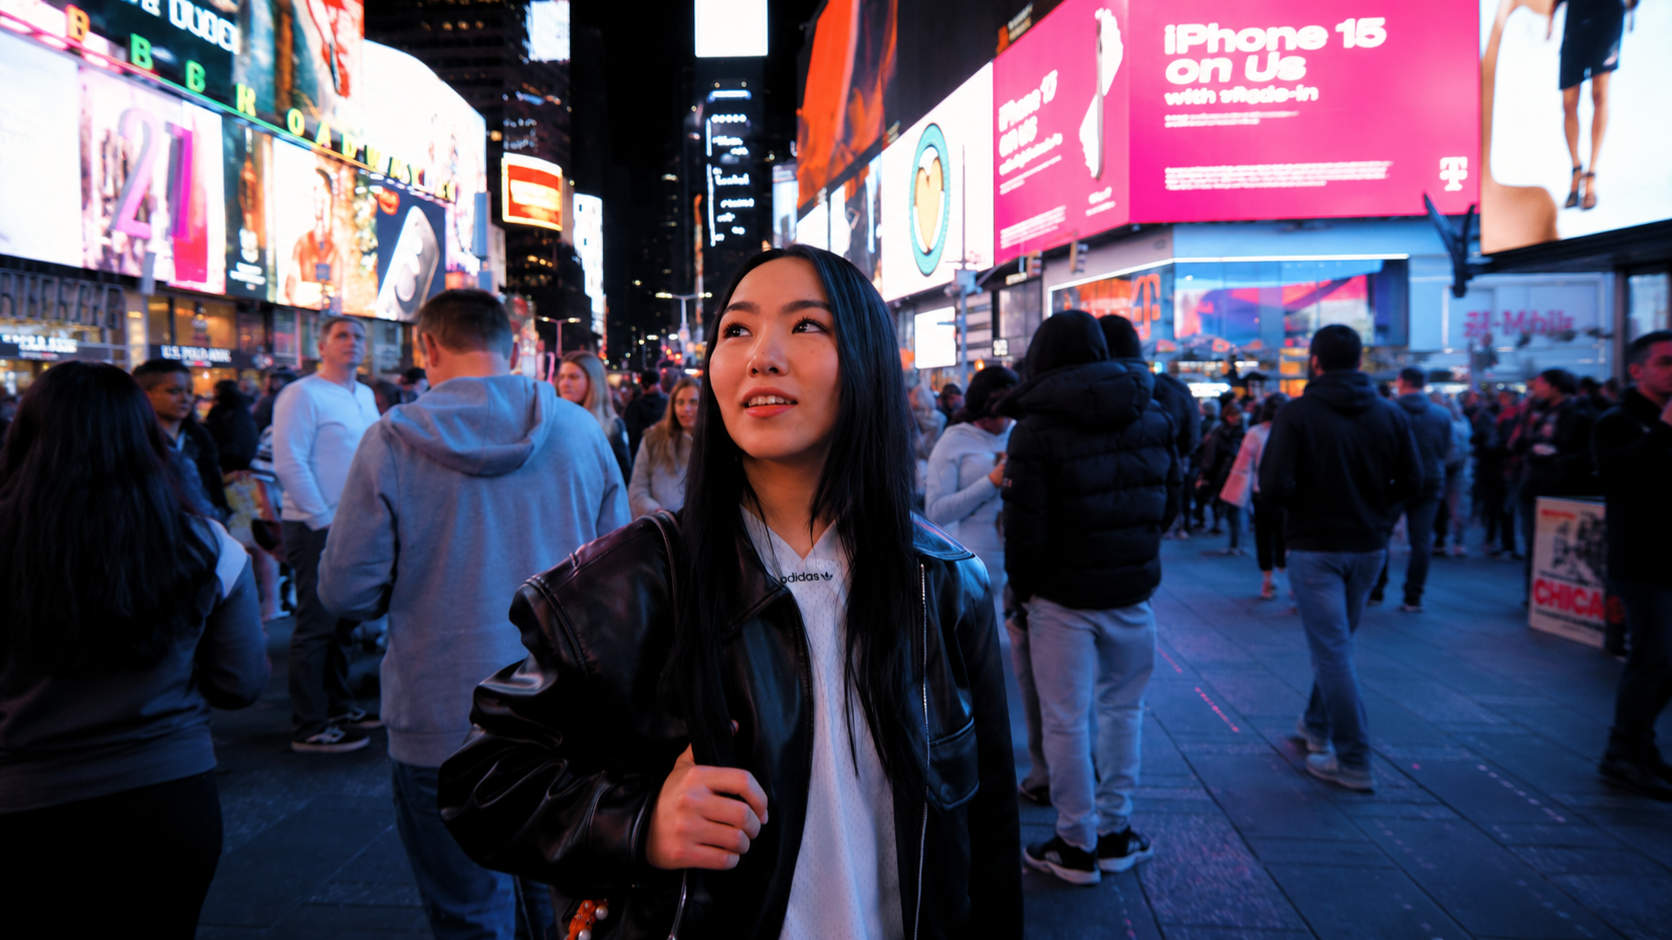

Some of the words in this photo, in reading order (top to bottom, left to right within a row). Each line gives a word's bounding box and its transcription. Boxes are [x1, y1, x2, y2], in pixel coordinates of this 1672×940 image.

[1164, 23, 1329, 55] iPhone
[1335, 17, 1388, 49] 15
[1165, 57, 1233, 85] on
[1245, 51, 1307, 82] Us
[1164, 88, 1217, 106] with
[780, 572, 820, 584] adidas
